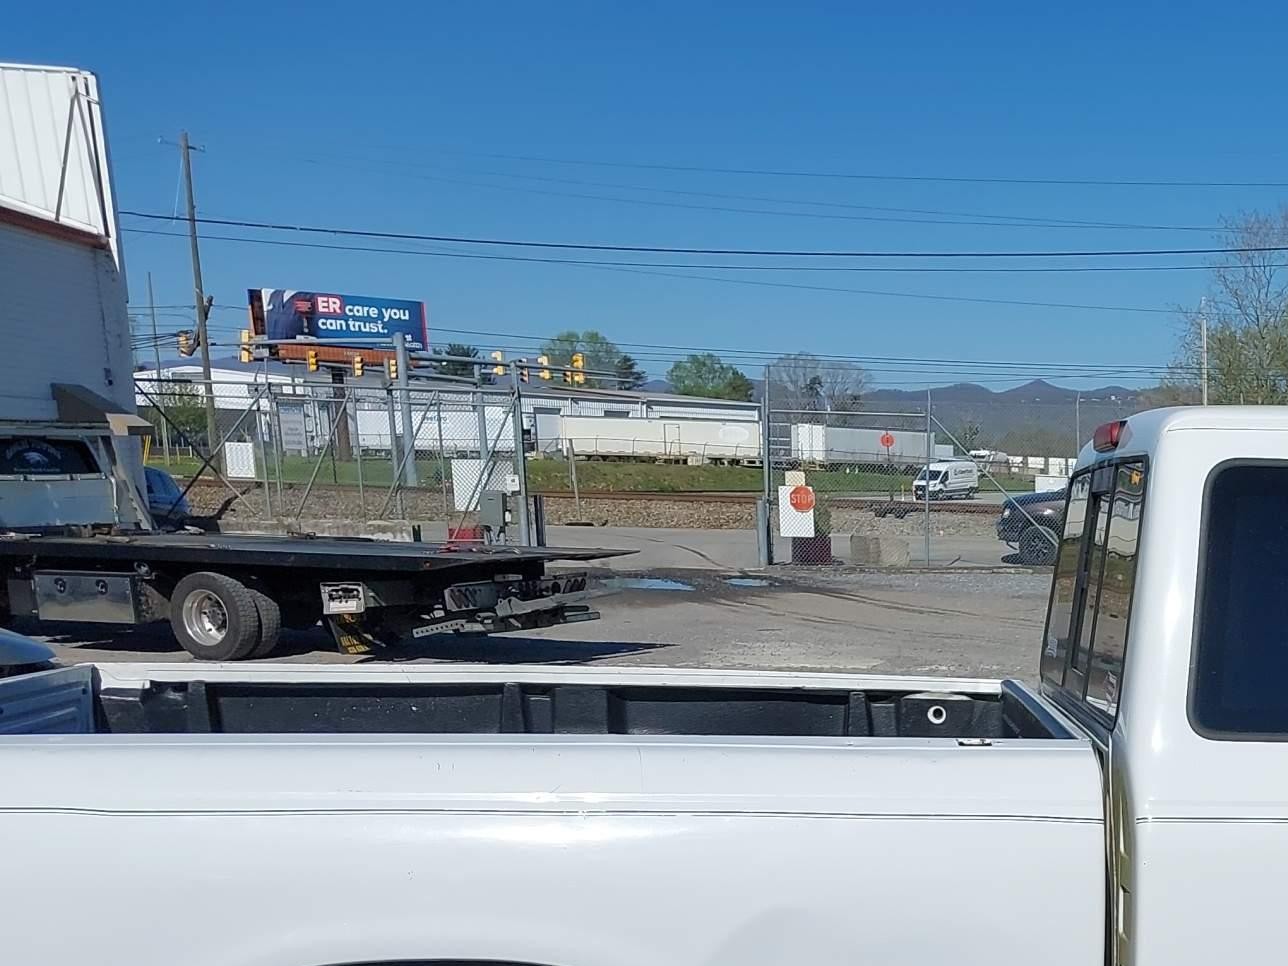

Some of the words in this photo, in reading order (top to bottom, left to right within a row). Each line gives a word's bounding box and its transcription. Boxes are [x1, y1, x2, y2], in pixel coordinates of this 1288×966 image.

[317, 297, 341, 313] ER
[345, 305, 379, 317] care
[382, 308, 409, 322] you
[318, 318, 346, 330] can
[348, 318, 388, 333] trust.
[791, 494, 814, 504] STOP
